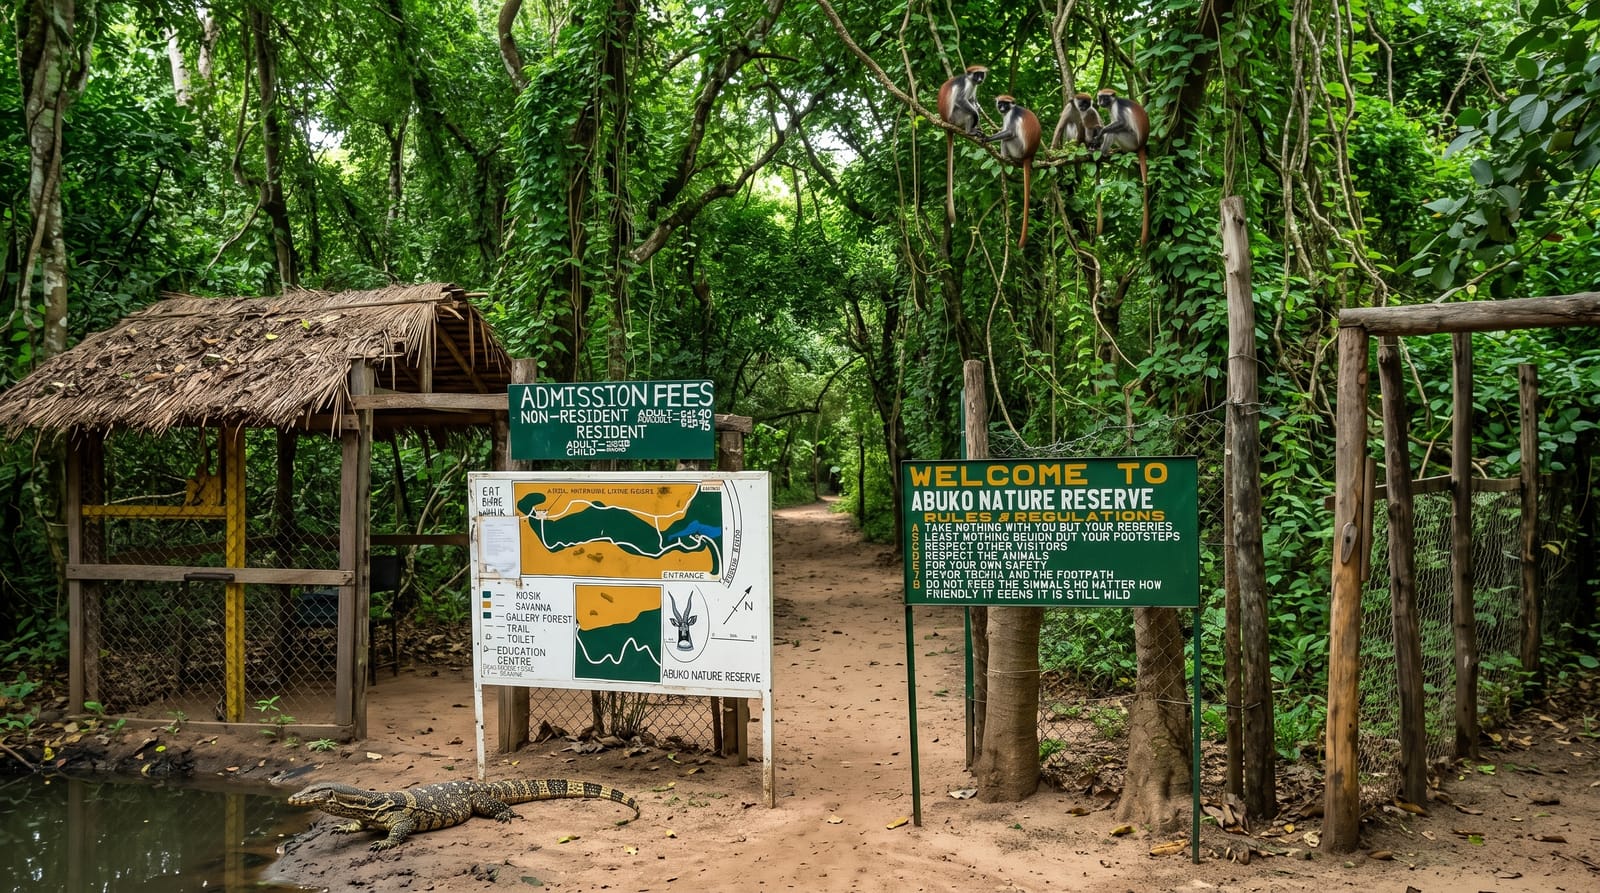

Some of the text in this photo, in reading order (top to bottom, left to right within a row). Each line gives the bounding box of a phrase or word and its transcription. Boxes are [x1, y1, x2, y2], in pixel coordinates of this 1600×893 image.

[521, 382, 714, 409] ADMISSION FEES
[521, 409, 629, 424] NON-RESIDENT
[577, 425, 647, 439] RESIDENT
[910, 462, 1168, 486] WELCOME TO
[483, 486, 500, 496] EAT
[912, 488, 1153, 511] ABUKO NATURE RESERVE
[924, 512, 992, 522] RULES
[1015, 511, 1165, 522] REGULATIONS
[925, 523, 952, 532] TAKE
[956, 523, 1001, 532] NOTHING
[1006, 523, 1030, 532] WITH
[1035, 523, 1055, 531] YOU
[1060, 523, 1080, 531] BUT
[1085, 523, 1113, 531] YOUR
[925, 533, 959, 542] LEAST
[1082, 532, 1110, 541] YOUR
[925, 542, 973, 550] RESPECT
[977, 542, 1012, 550] OTHER
[1017, 542, 1068, 550] VISITORS
[925, 552, 973, 560] RESPECT
[978, 552, 998, 560] THE
[1003, 552, 1049, 560] ANIMALS
[926, 561, 946, 569] FOR
[950, 561, 976, 569] YOUR
[980, 561, 1002, 569] OWN
[1006, 561, 1047, 569] SAFETY
[1009, 570, 1030, 579] AND
[1033, 570, 1053, 579] THE
[1057, 570, 1114, 579] FOOTPATH
[926, 580, 940, 589] DO
[944, 580, 964, 589] NOT
[999, 580, 1020, 589] THE
[1092, 580, 1135, 589] MATTER
[1140, 580, 1162, 589] HOW
[516, 592, 541, 600] KIOSIK
[926, 590, 1130, 599] FRIENDLY IT EEENS IT IS STILL WILD
[516, 603, 552, 612] SAVANNA
[745, 602, 753, 611] N
[506, 613, 572, 623] GALLERY FOREST
[507, 624, 530, 633] TRAIL
[507, 635, 535, 643] TOILET
[497, 646, 546, 656] EDUCATION
[498, 656, 531, 666] CENTRE
[664, 669, 760, 682] ABUKO NATURE RESERVE
